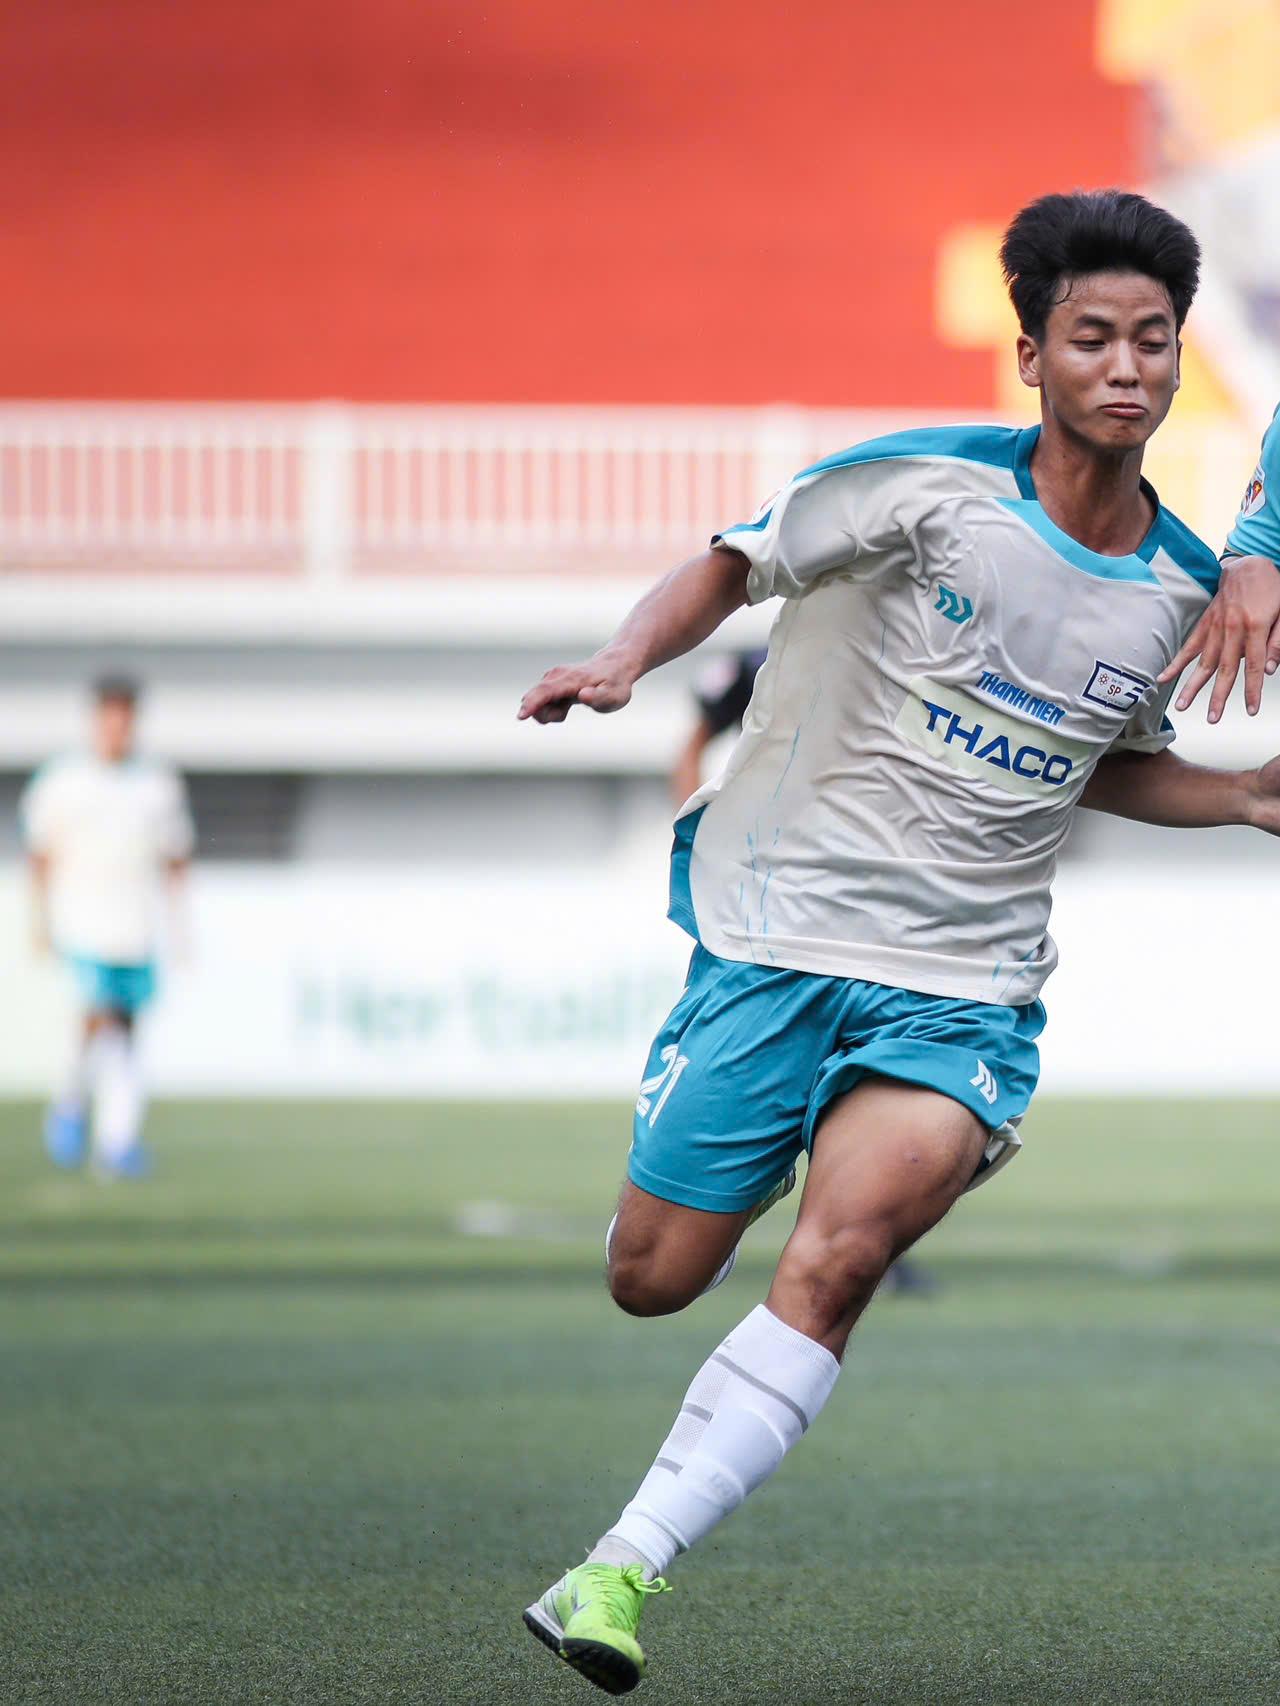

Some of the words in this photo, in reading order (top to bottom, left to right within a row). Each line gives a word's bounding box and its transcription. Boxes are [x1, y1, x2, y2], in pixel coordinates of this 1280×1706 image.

[976, 670, 1031, 710] THANH
[1107, 684, 1122, 696] SP
[921, 699, 1073, 785] THACO
[636, 1043, 690, 1128] 21
